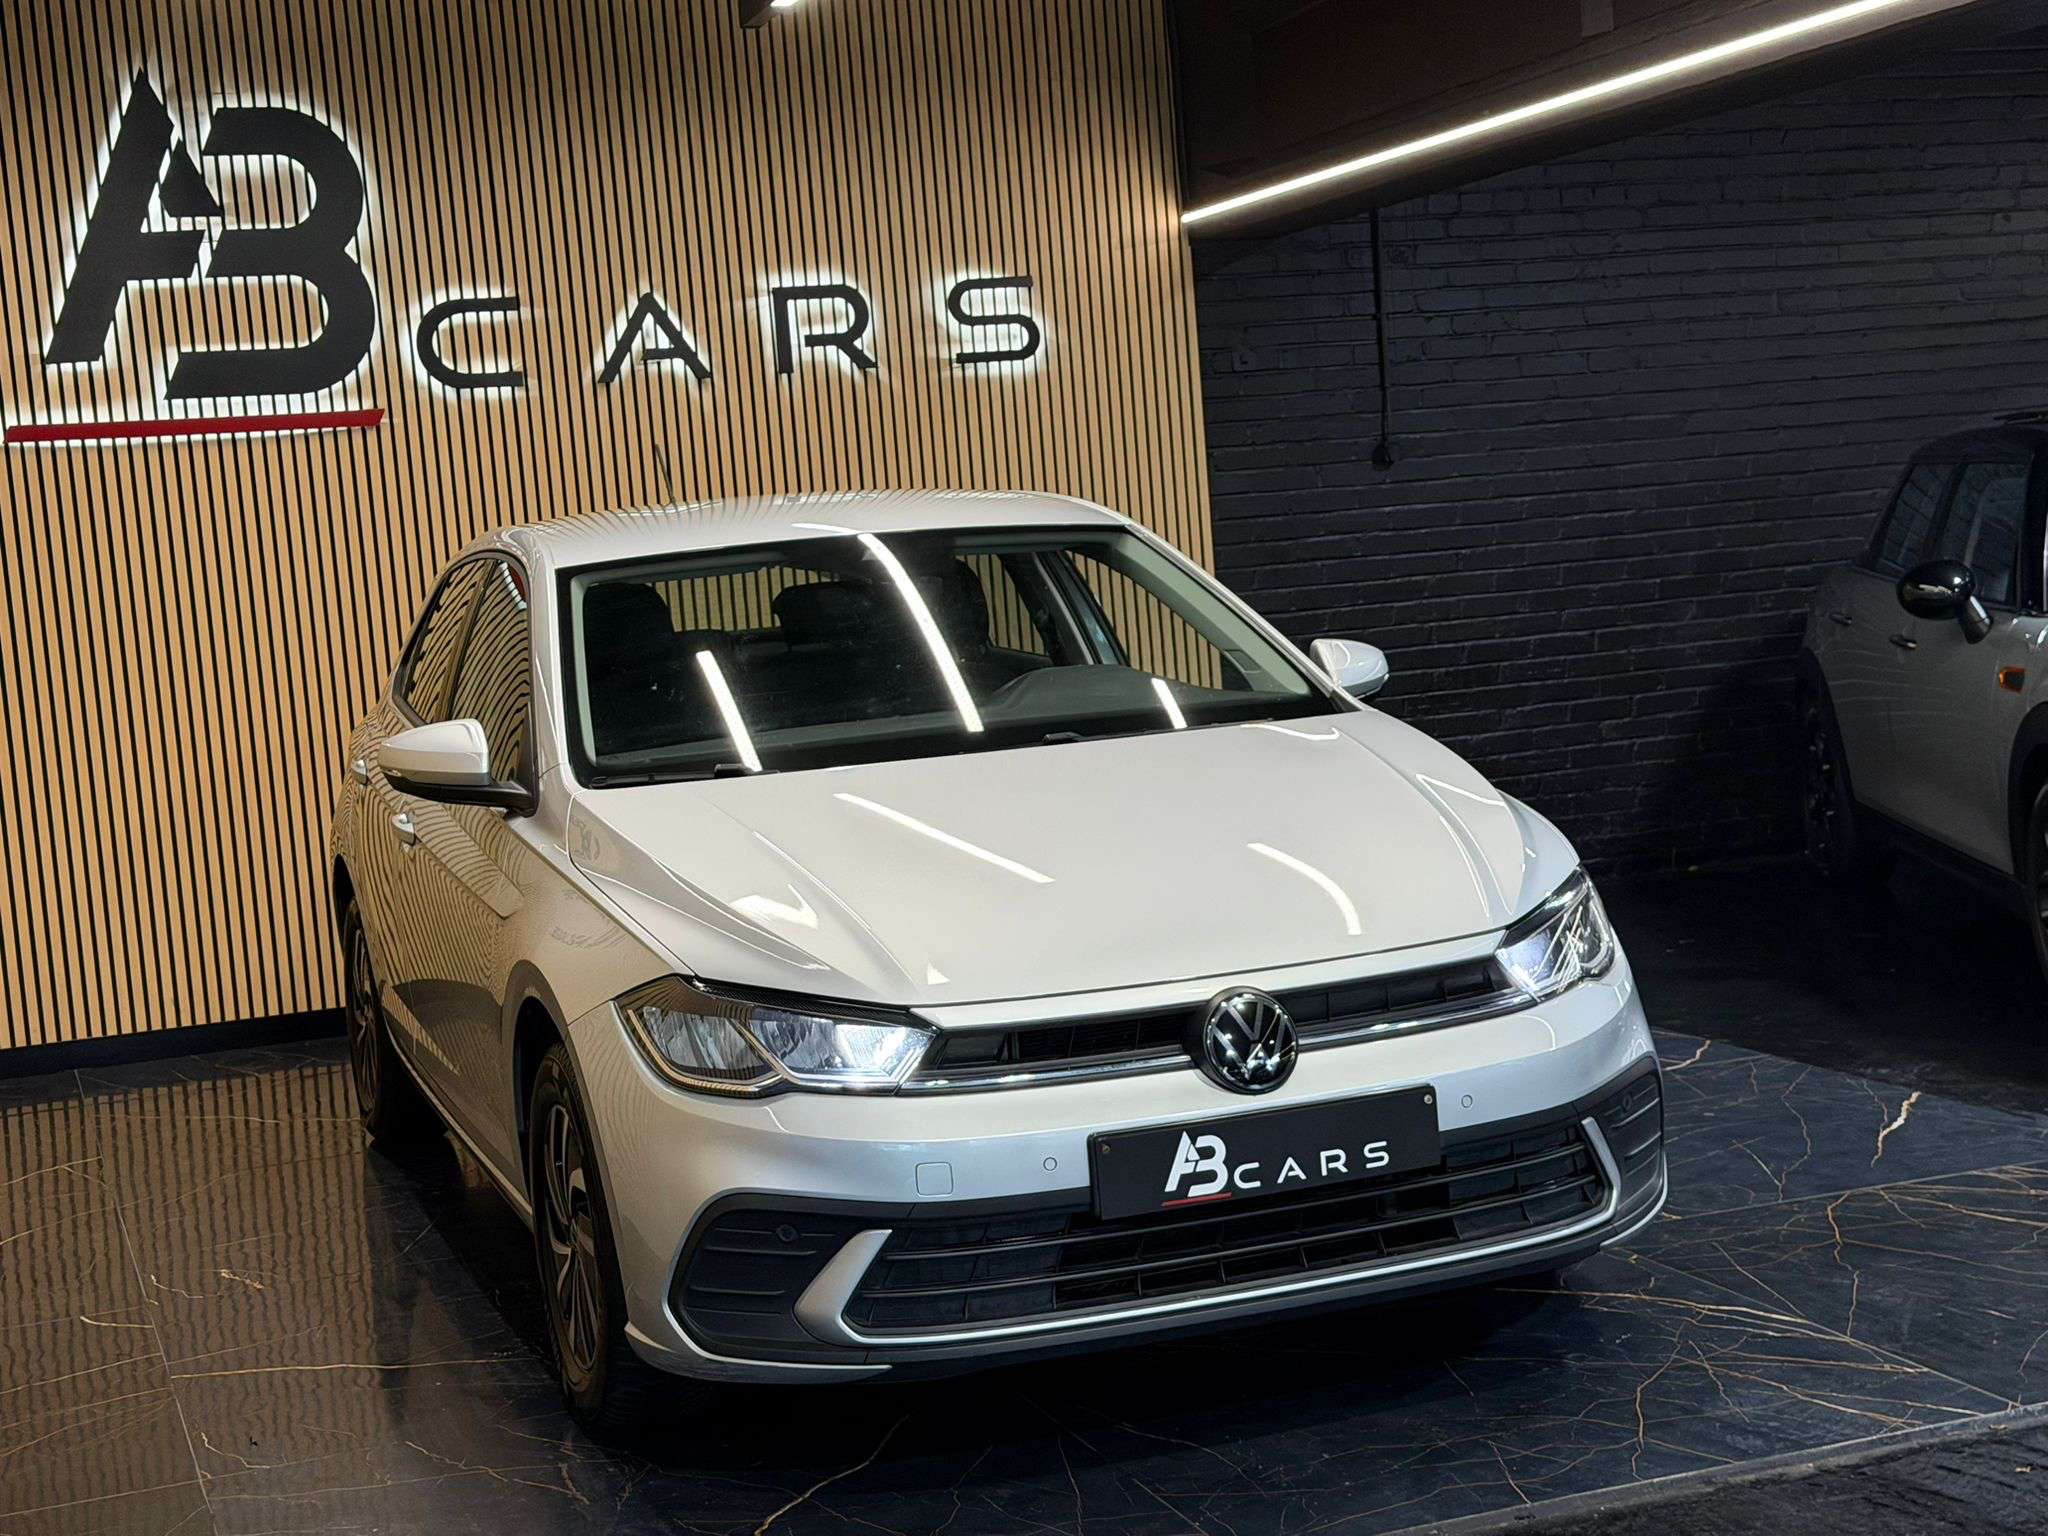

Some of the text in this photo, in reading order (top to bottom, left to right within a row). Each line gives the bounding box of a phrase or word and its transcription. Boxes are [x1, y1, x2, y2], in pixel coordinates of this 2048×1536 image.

[45, 67, 1040, 400] AB CARS
[1164, 1131, 1390, 1197] AB CARS
